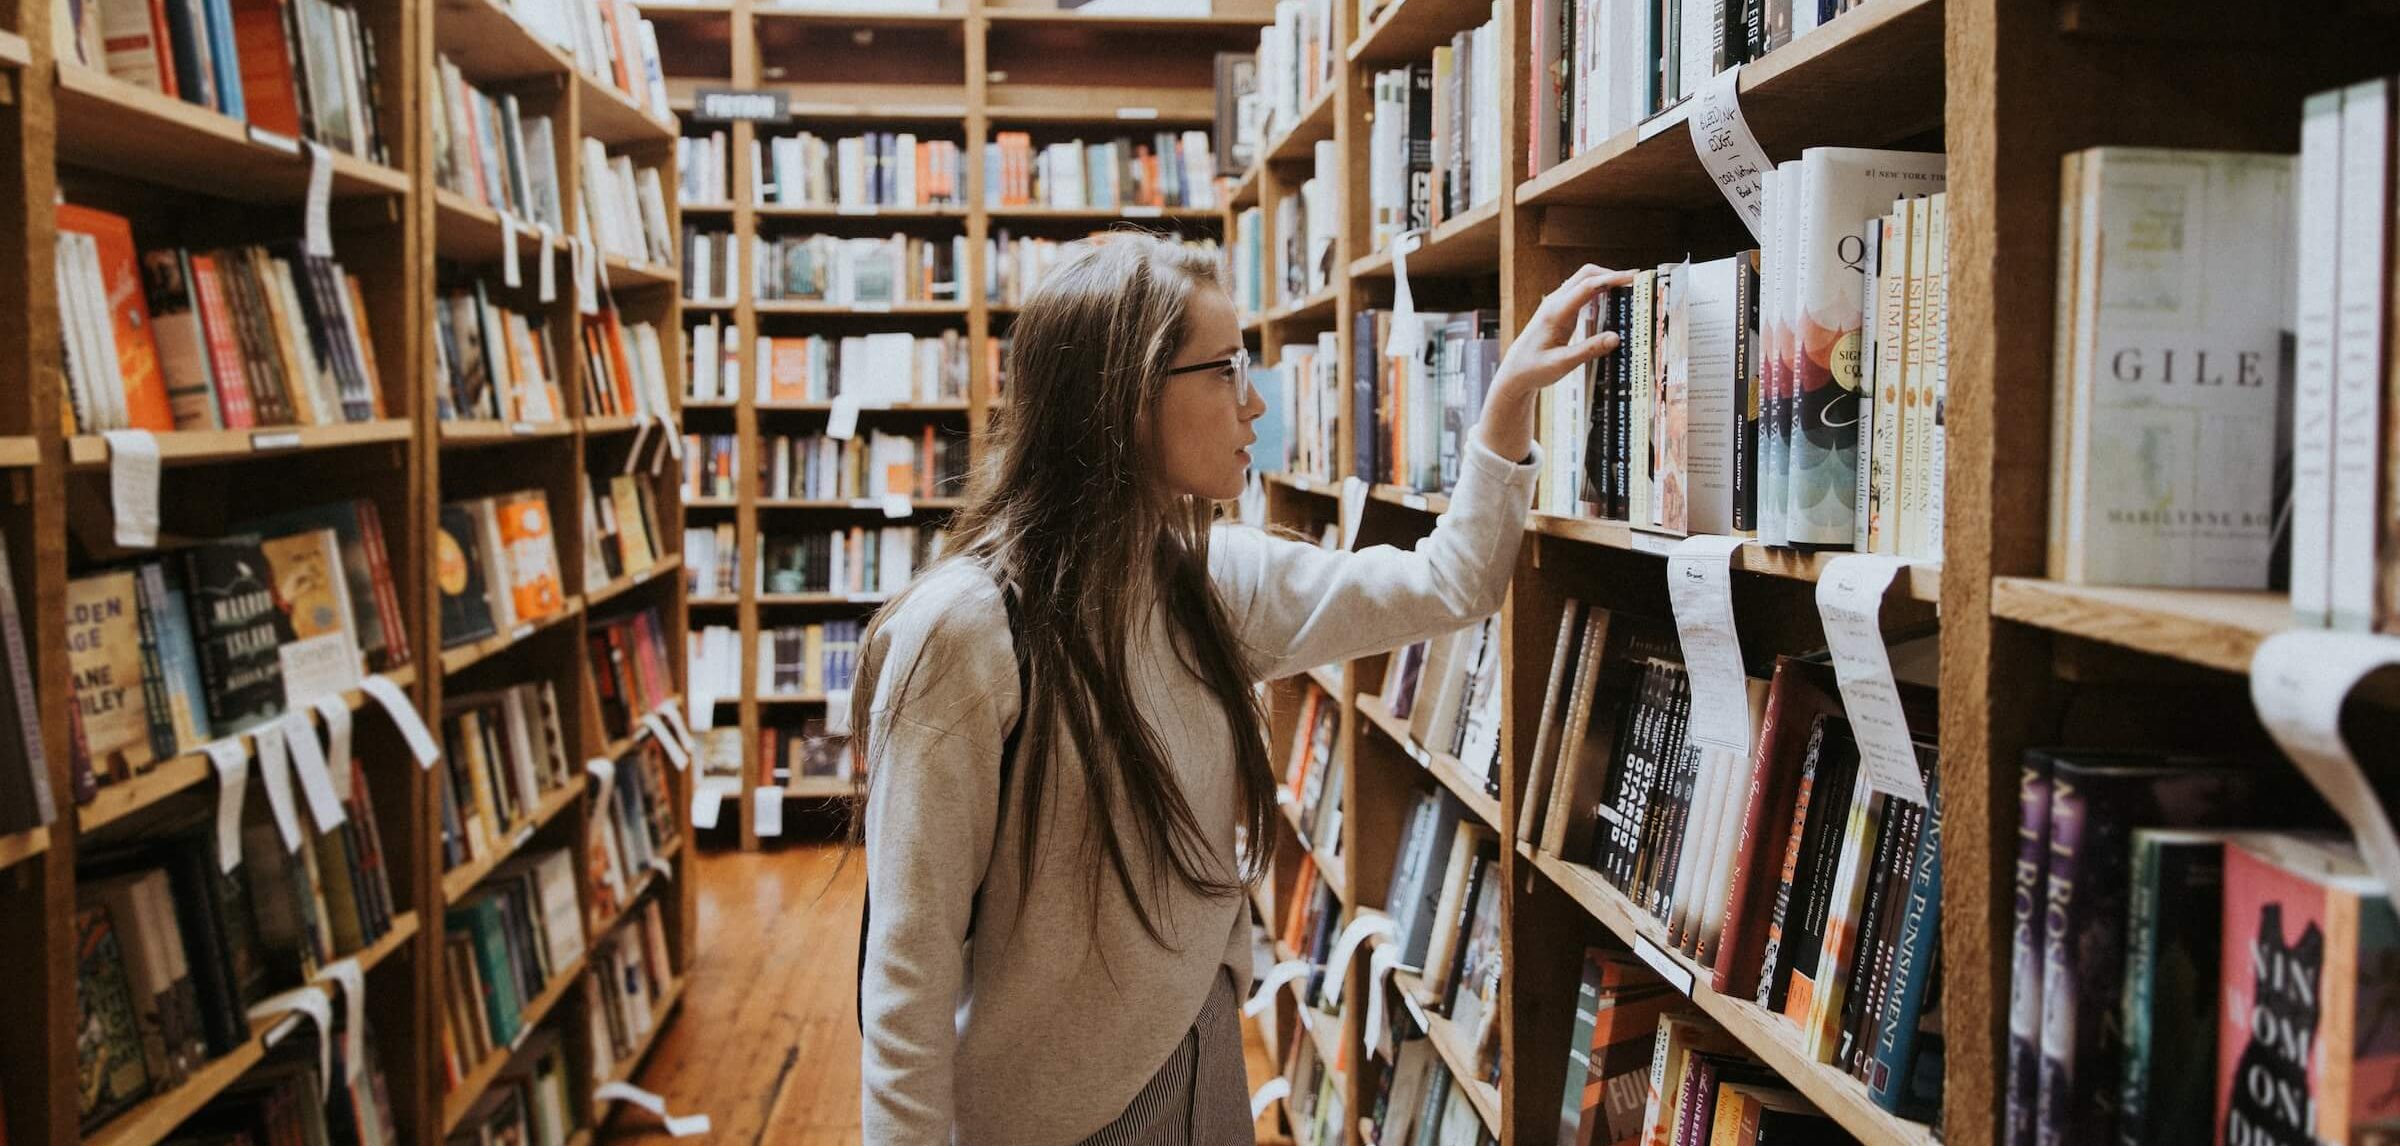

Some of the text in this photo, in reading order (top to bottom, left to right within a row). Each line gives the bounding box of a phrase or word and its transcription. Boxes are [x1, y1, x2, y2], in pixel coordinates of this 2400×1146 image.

[1713, 18, 1724, 55] EDGE
[1747, 8, 1759, 47] EDGE
[1879, 170, 1898, 179] NEW
[1902, 172, 1927, 181] YORK
[1738, 264, 1747, 340] Monument
[1886, 275, 1902, 363] ISHMAEL
[1907, 277, 1922, 365] ISHMAEL
[1924, 274, 1940, 363] ISHMAEL
[2112, 348, 2263, 388] GILE
[1617, 461, 1625, 497] QUICK
[1858, 414, 1868, 513] Anna Quindlen
[1882, 413, 1893, 505] DANIEL QUINN
[1903, 417, 1914, 511] DANIEL QUINN
[1919, 416, 1931, 512] DANIEL QUINN
[1650, 713, 1669, 788] IMPERFECTIONISTS
[1659, 715, 1678, 791] IMPERFECTIONISTS
[1666, 719, 1685, 795] IMPERFECTIONISTS
[1758, 717, 1774, 762] Devil
[1754, 759, 1762, 775] in
[1620, 757, 1645, 848] OTARED
[1628, 762, 1654, 853] OTARED
[1737, 774, 1761, 852] Jerusalem
[1901, 808, 1911, 834] WHY
[1911, 812, 1921, 838] WHY
[1817, 852, 1825, 872] Story
[1826, 857, 1834, 877] Story
[1892, 846, 1903, 875] CAME
[1903, 851, 1914, 880] CAME
[1727, 866, 1741, 908] NAOMI
[1805, 890, 1816, 931] Childhood
[1814, 895, 1825, 936] Childhood
[1854, 910, 1874, 993] CROCODILES
[1874, 939, 1885, 971] MARY
[1882, 893, 1927, 1053] PUNISHMENT
[1883, 946, 1895, 978] MARY
